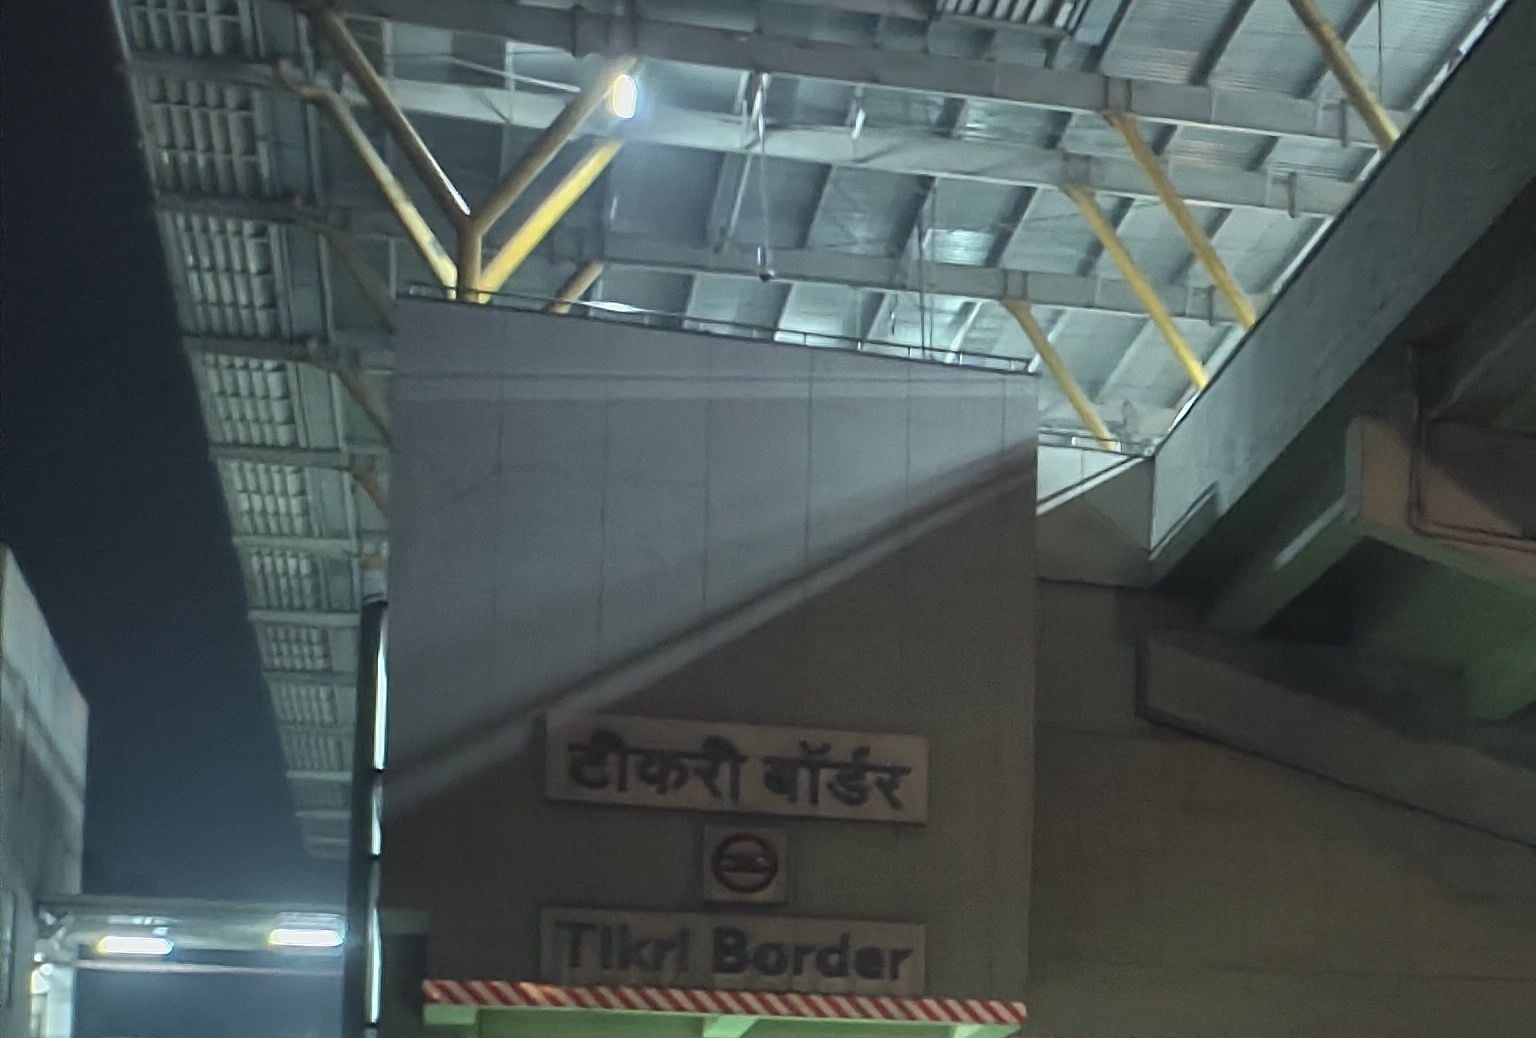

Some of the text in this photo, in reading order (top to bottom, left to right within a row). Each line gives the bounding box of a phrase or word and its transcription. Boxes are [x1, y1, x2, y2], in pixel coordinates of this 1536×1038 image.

[567, 728, 913, 811] टीकरी बॉर्डर
[555, 919, 913, 983] Tikri Border
